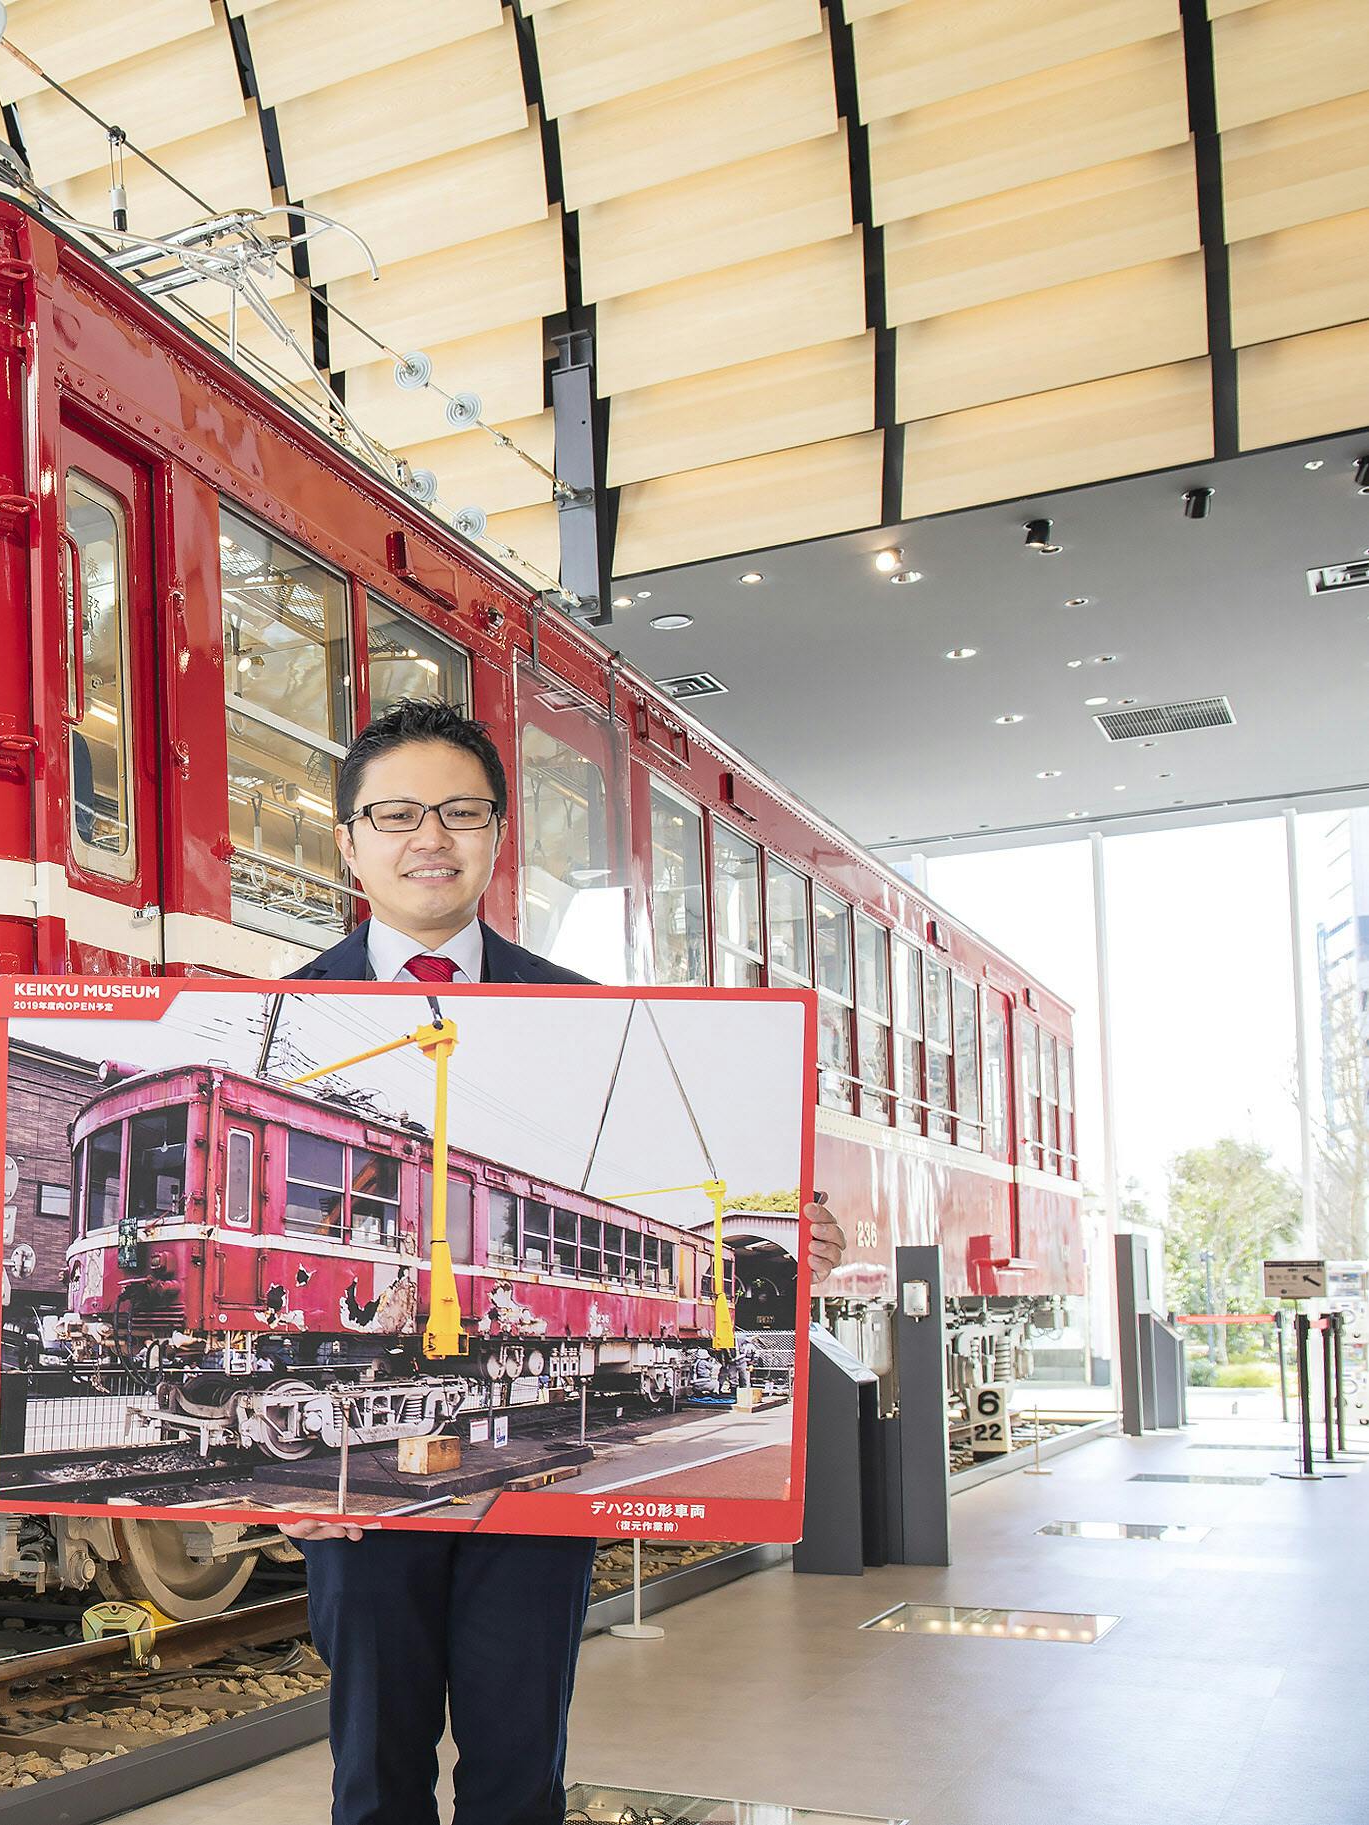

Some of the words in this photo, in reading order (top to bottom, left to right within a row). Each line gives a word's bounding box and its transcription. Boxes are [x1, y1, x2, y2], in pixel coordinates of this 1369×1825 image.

[14, 982, 79, 997] KEIKYU
[84, 984, 160, 999] MUSEUM
[13, 1000, 114, 1012] 2019年度内OPEN予定
[856, 1220, 878, 1249] 236
[977, 1390, 1000, 1416] 6
[974, 1423, 1003, 1441] 22
[590, 1500, 707, 1519] デハ230形車両
[615, 1520, 680, 1533] （復元作業前）
